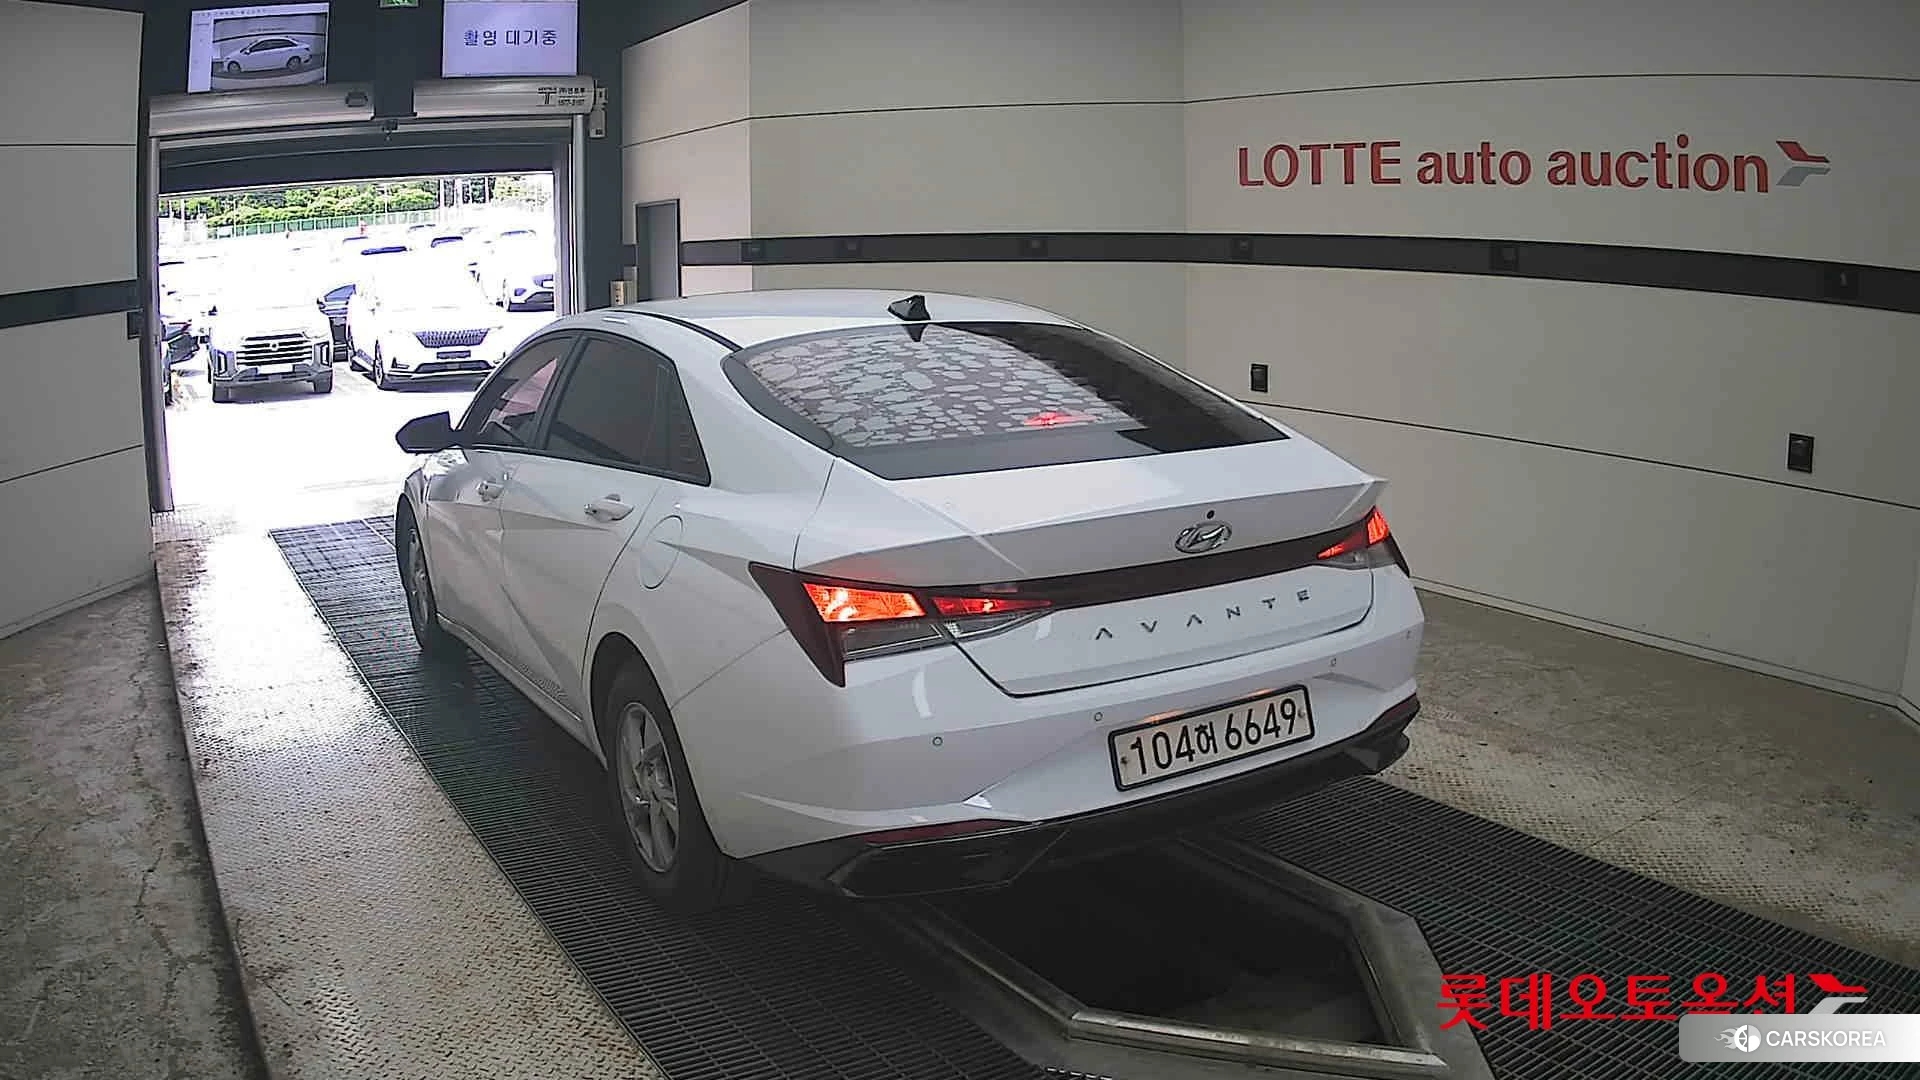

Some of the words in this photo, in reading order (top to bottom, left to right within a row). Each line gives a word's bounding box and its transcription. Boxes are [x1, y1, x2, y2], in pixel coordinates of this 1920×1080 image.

[505, 29, 557, 46] 대기중
[1239, 141, 1401, 187] LOTTE
[1416, 142, 1532, 185] auto
[1547, 134, 1769, 193] auction
[1095, 589, 1311, 641] AVANTE
[1225, 698, 1297, 750] 6649
